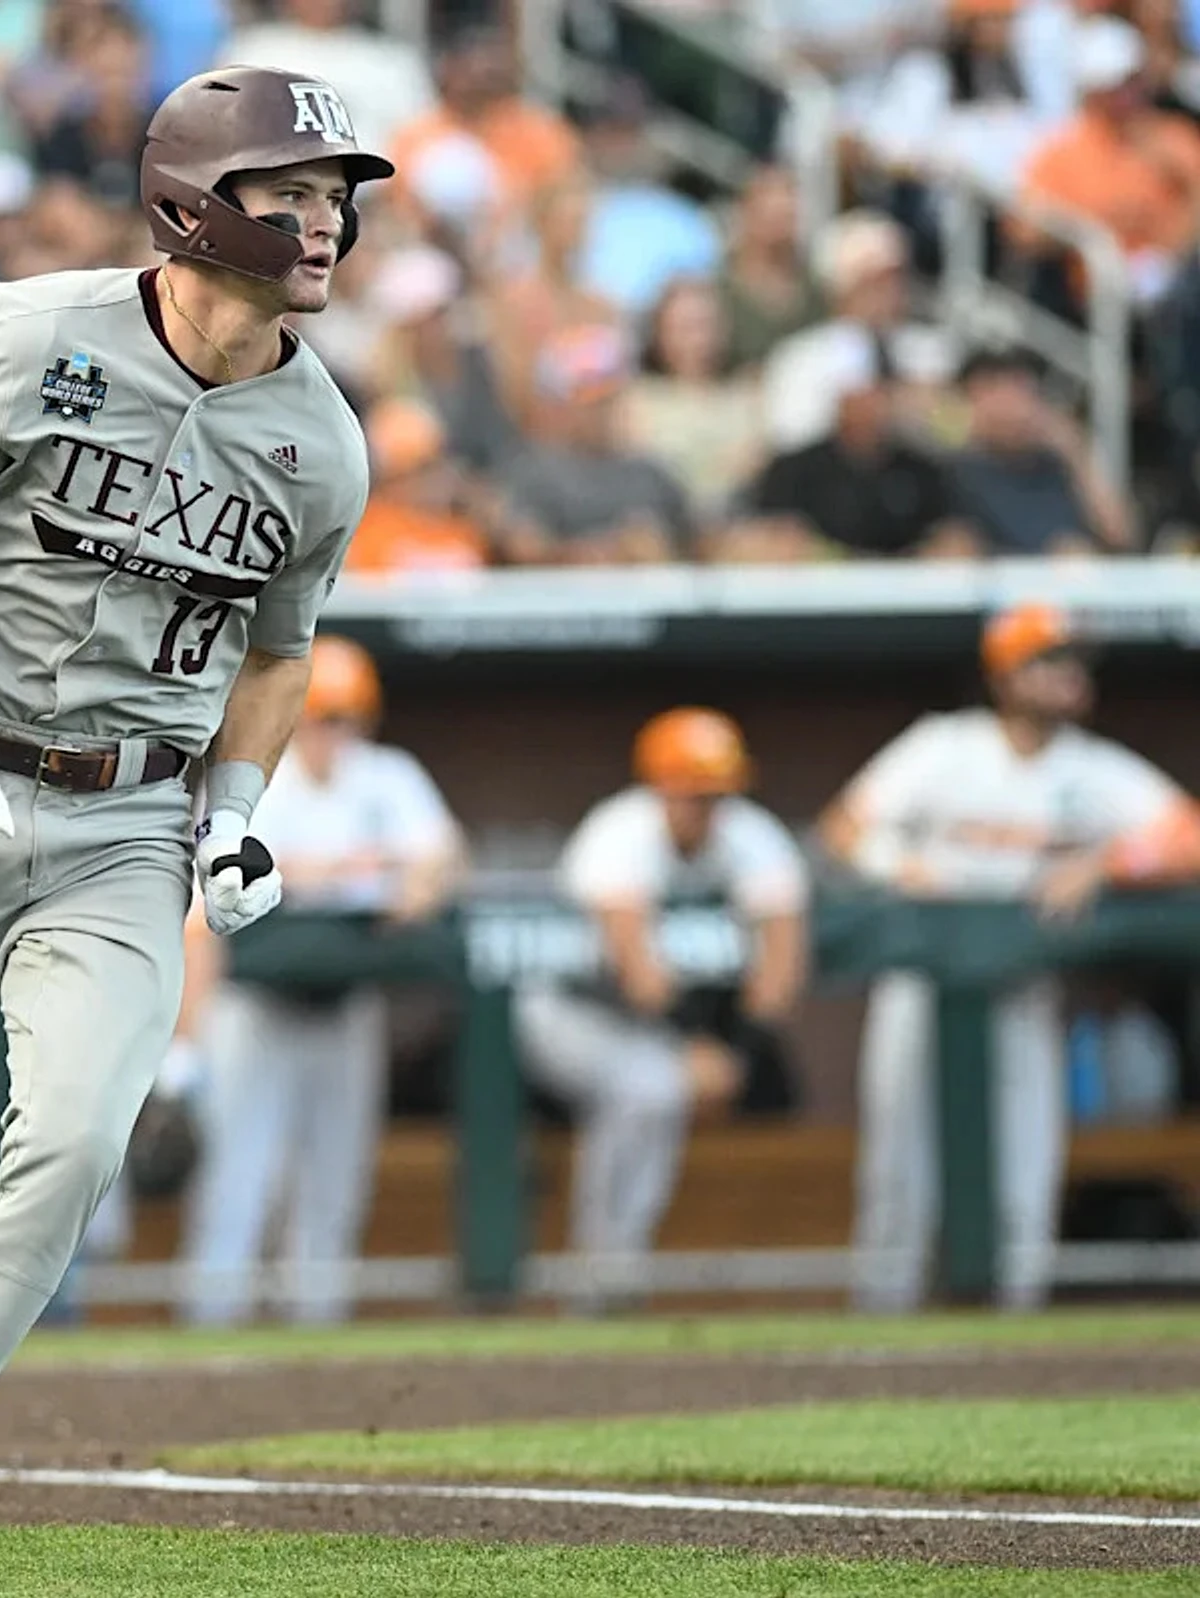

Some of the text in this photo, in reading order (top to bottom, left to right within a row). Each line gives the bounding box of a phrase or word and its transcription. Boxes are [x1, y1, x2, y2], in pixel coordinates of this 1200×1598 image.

[52, 434, 291, 574] TEXAS
[75, 537, 194, 584] AGGIES
[151, 595, 233, 676] 13
